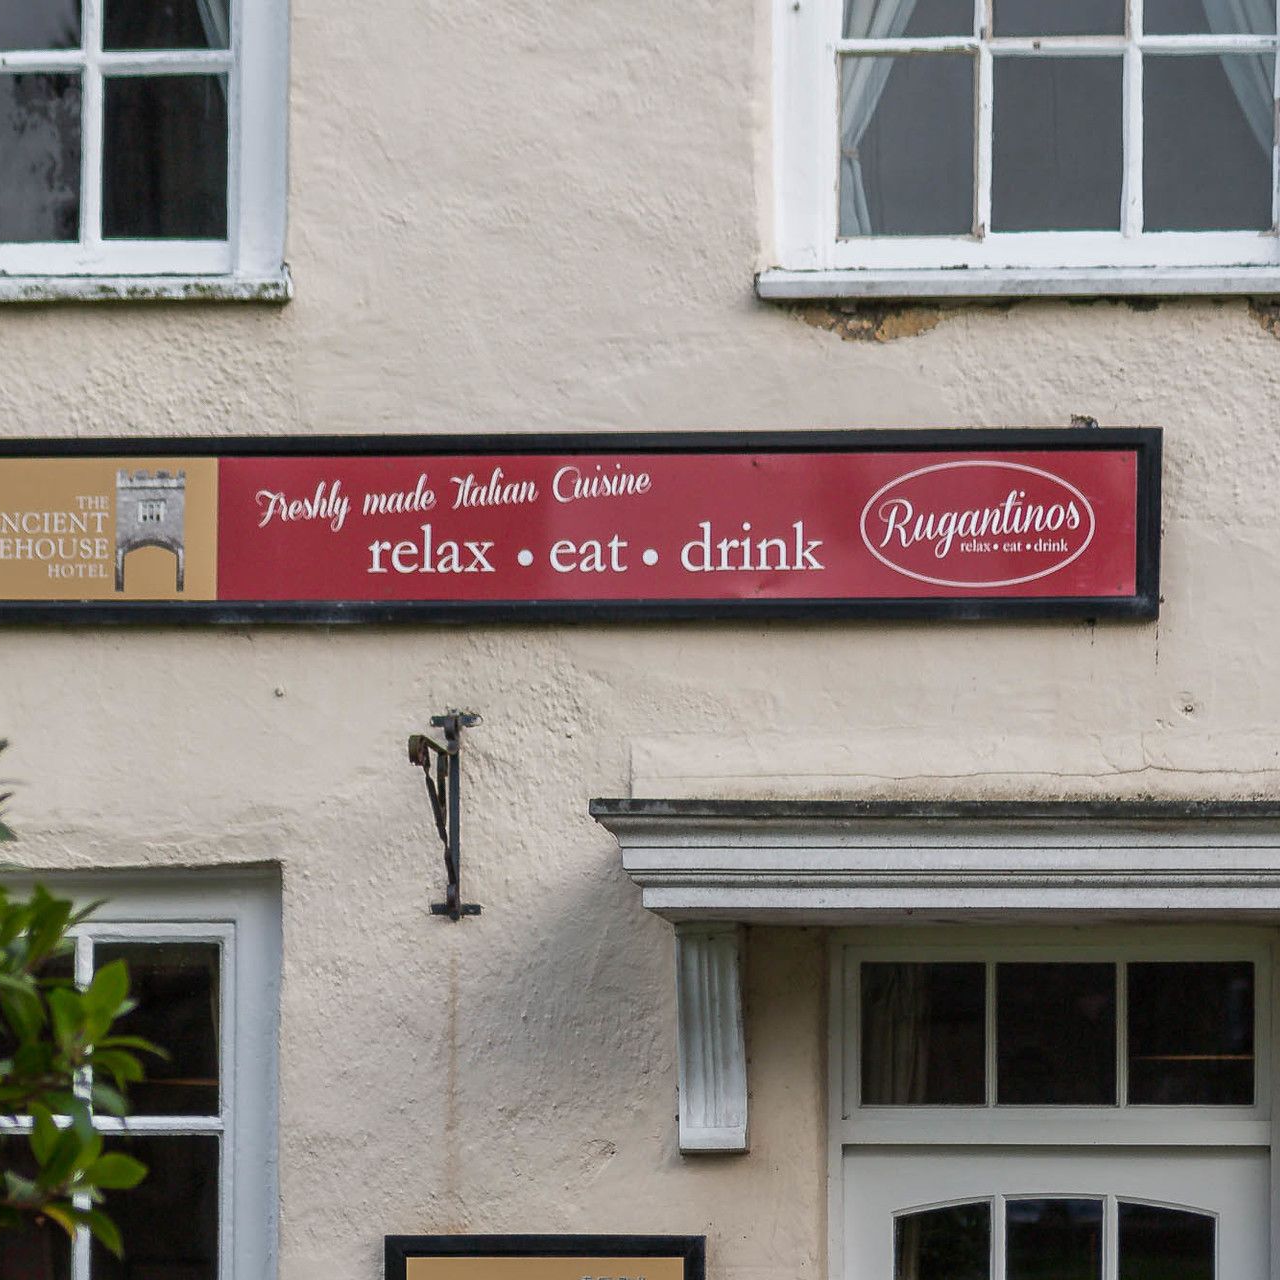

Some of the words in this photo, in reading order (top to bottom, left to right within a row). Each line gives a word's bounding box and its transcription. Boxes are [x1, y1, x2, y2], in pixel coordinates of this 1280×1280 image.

[76, 495, 110, 510] THE
[255, 480, 351, 532] Freshly
[363, 473, 437, 515] made
[450, 467, 538, 510] Italian
[553, 464, 652, 504] Cuisine
[878, 490, 1081, 559] Rugantinos
[367, 524, 496, 574] relax
[550, 534, 629, 573] eat
[680, 521, 825, 573] drink
[960, 538, 991, 552] relax
[1003, 540, 1022, 552] eat
[1034, 538, 1068, 552] drink
[48, 563, 110, 578] HOTEL
